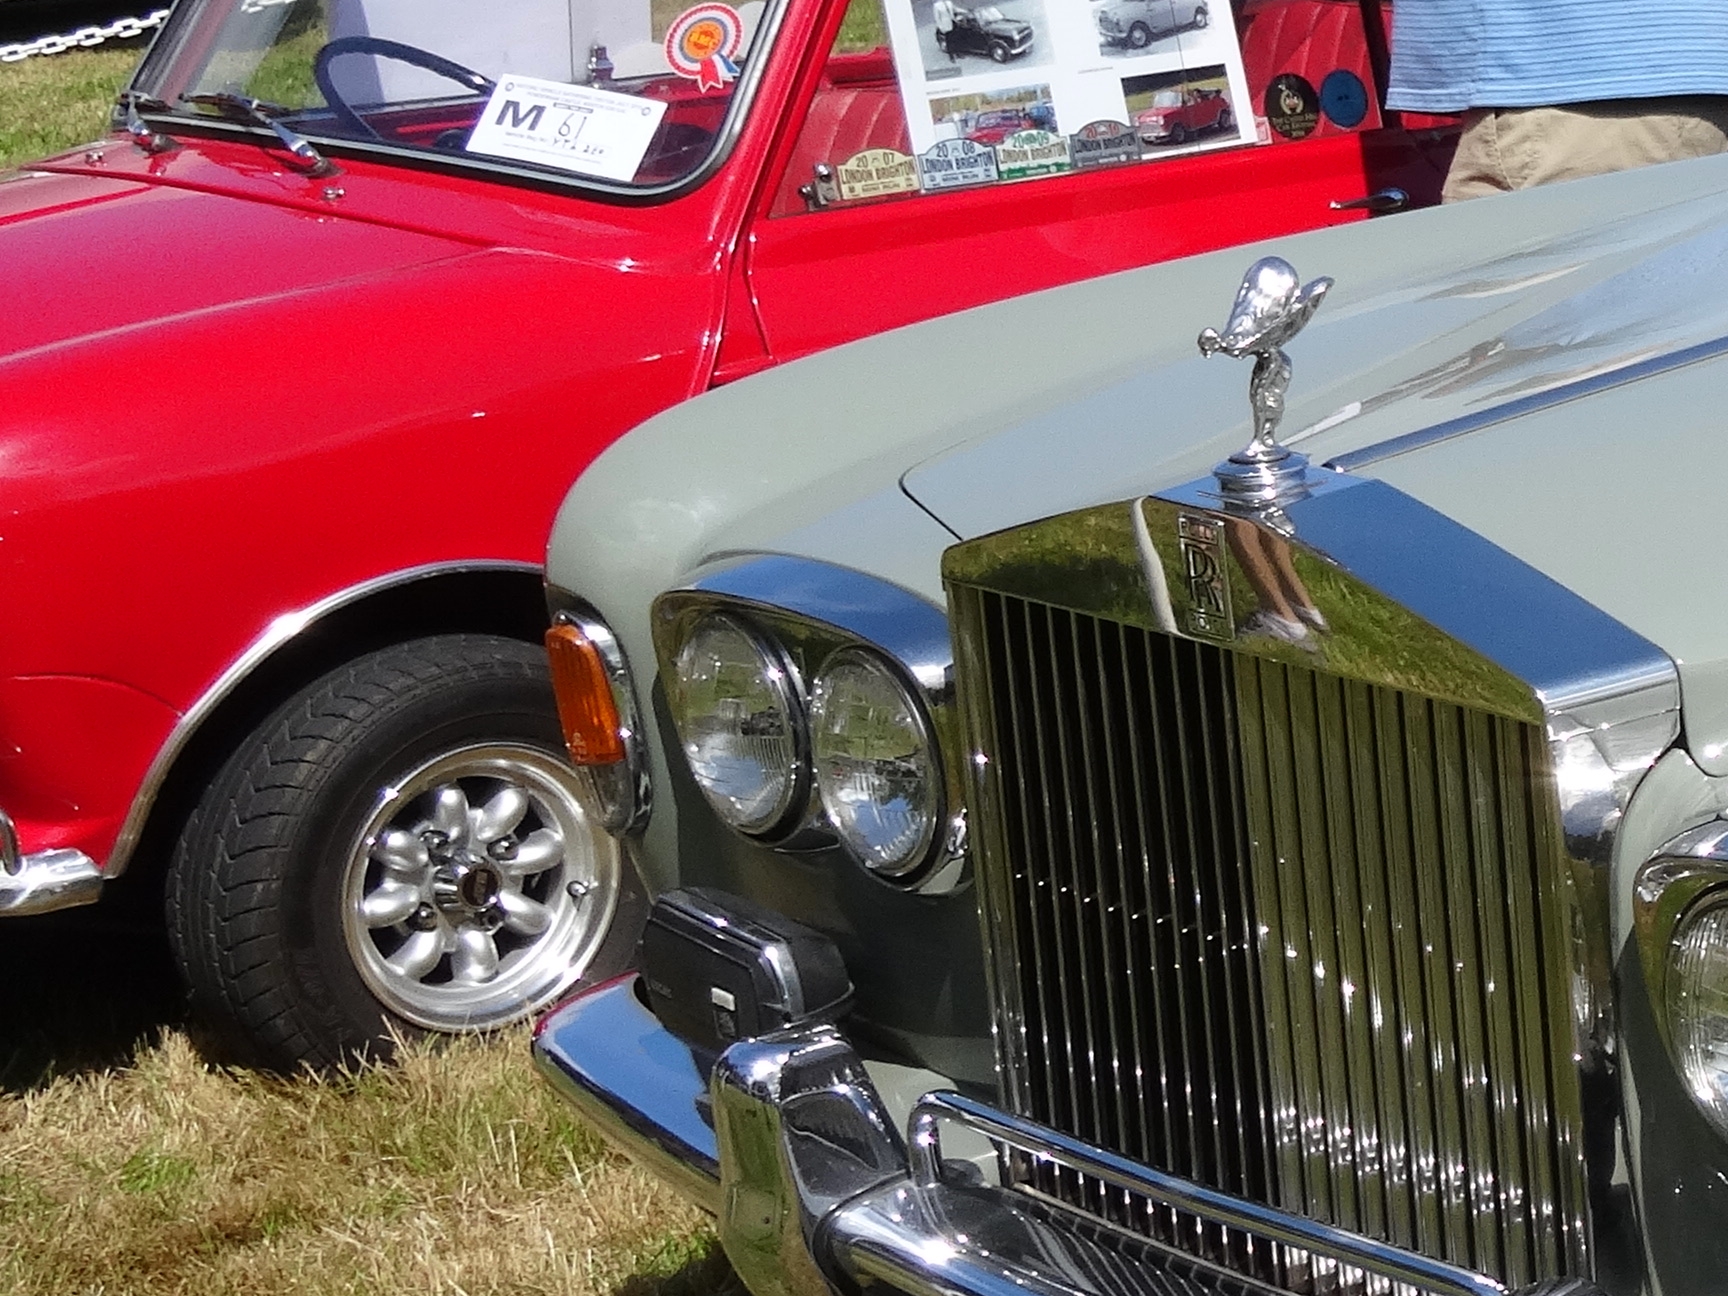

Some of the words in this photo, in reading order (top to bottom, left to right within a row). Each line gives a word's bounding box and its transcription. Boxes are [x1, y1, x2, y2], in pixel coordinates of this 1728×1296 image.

[494, 99, 548, 132] M
[557, 112, 589, 140] 61
[856, 154, 869, 168] 20
[882, 151, 896, 165] 07
[920, 157, 954, 175] LONDON
[955, 149, 995, 171] BRIGHTON
[935, 144, 950, 159] 20
[961, 140, 976, 155] 08
[999, 147, 1029, 165] LONDON
[1029, 139, 1068, 161] BRIGHTON
[840, 167, 874, 185] LONDON
[876, 158, 917, 180] BRIGHTON
